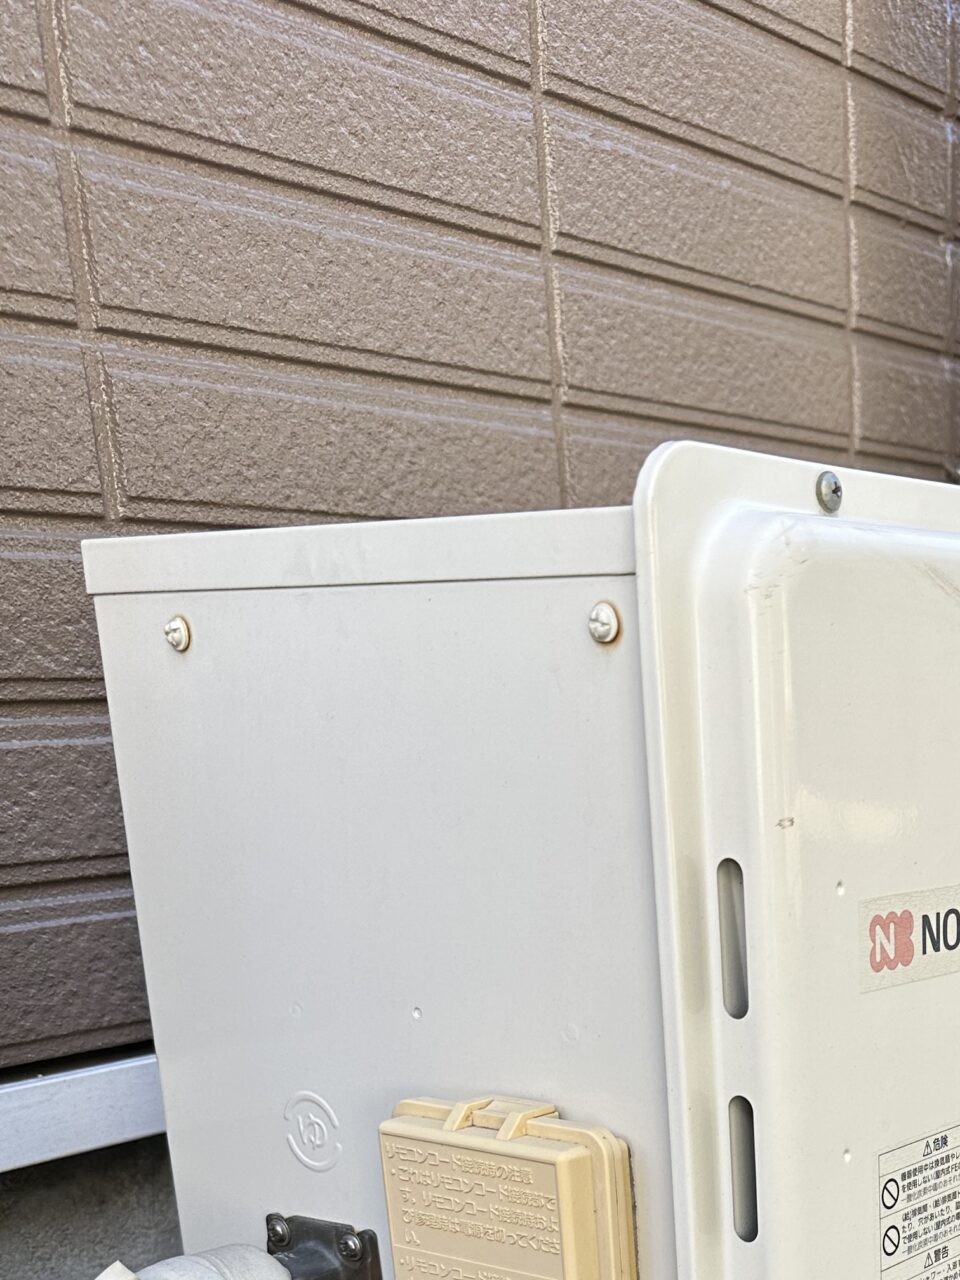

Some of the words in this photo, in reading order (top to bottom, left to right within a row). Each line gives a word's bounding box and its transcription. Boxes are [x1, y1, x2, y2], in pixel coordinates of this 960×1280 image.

[297, 1114, 328, 1150] ゆ
[932, 1132, 949, 1152] 危険
[933, 1243, 949, 1263] 警告
